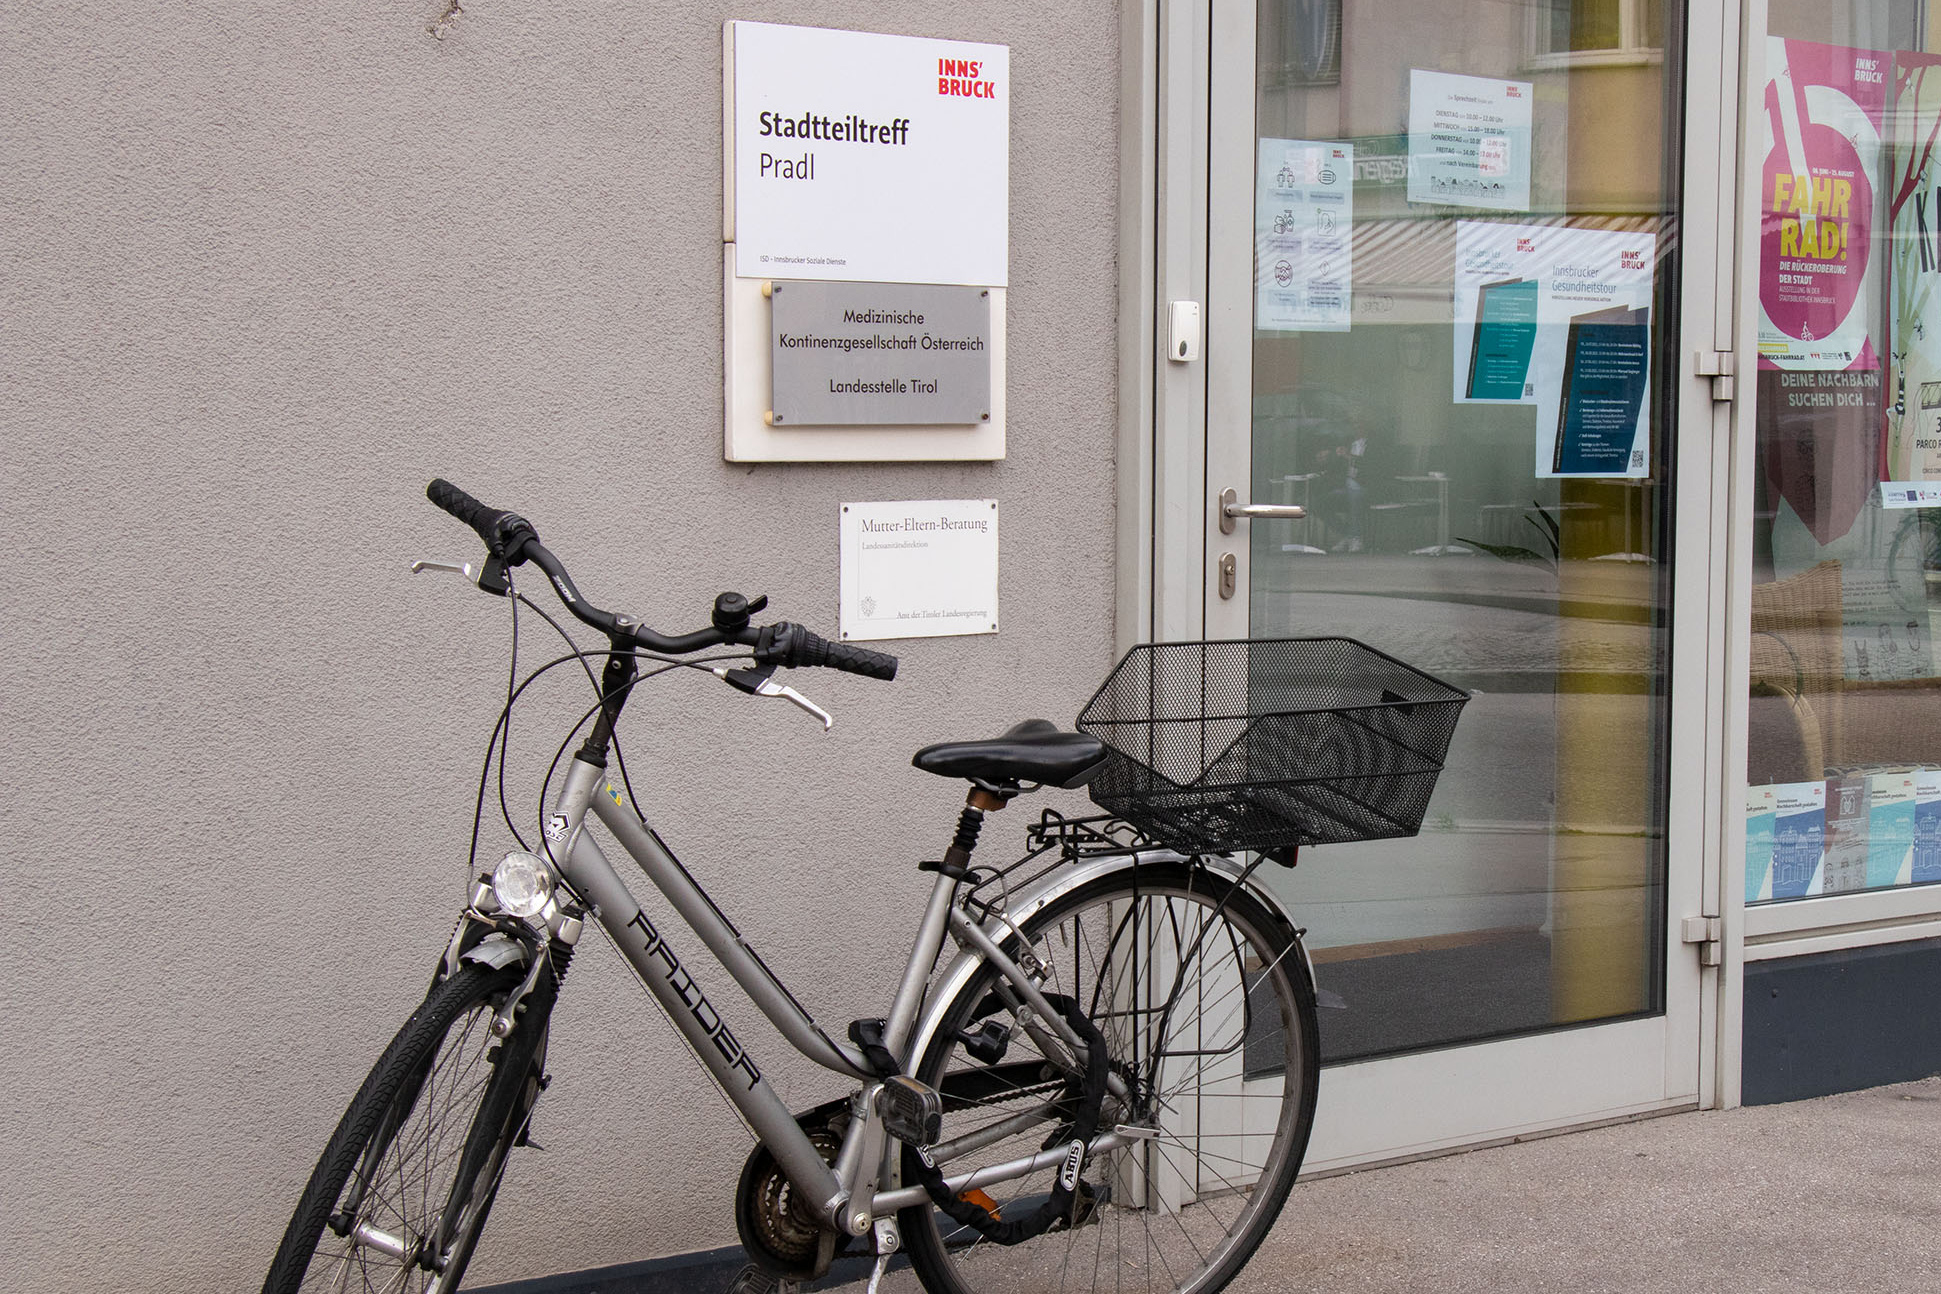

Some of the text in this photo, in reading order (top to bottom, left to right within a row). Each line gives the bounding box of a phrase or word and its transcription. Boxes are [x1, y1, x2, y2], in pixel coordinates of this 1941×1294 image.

[938, 58, 983, 78] INNS'
[1855, 69, 1883, 84] BRUCK
[938, 78, 995, 99] BRUCK
[1435, 109, 1459, 118] DIENSTAG
[759, 111, 910, 145] Stadtteiltreff
[1433, 121, 1460, 131] MITTWOCH
[1431, 133, 1462, 143] DONNERSTAG
[1435, 146, 1455, 154] FREITAG
[760, 153, 815, 180] Pradl
[1773, 173, 1852, 218] FAHR
[1780, 218, 1849, 261] RAD!
[759, 255, 770, 263] ISD
[774, 255, 806, 264] Innsbrucker
[806, 256, 825, 265] Soziale
[826, 257, 847, 265] Dienste
[1621, 260, 1646, 270] BRUCK
[1779, 260, 1847, 275] DIE RÜCKEROBERUNG
[1552, 264, 1599, 278] Innsbrucker
[1552, 280, 1617, 294] Gesundheitstour
[1779, 274, 1813, 285] DER STADT
[843, 309, 925, 325] Medizinische
[779, 331, 984, 352] Kontinenzgesellschaft Österreich
[829, 378, 938, 394] Landesstelle Tirol
[1781, 373, 1879, 387] DEINE NACHBARN
[1788, 392, 1834, 407] SUCHEN
[1836, 392, 1864, 407] DICH
[1916, 439, 1937, 449] PARCO
[862, 517, 988, 533] Mutter-Eltern-Beratung
[896, 611, 910, 619] Amt
[911, 611, 921, 619] der
[921, 610, 941, 619] Tiroler
[1065, 1146, 1080, 1183] ABUS
